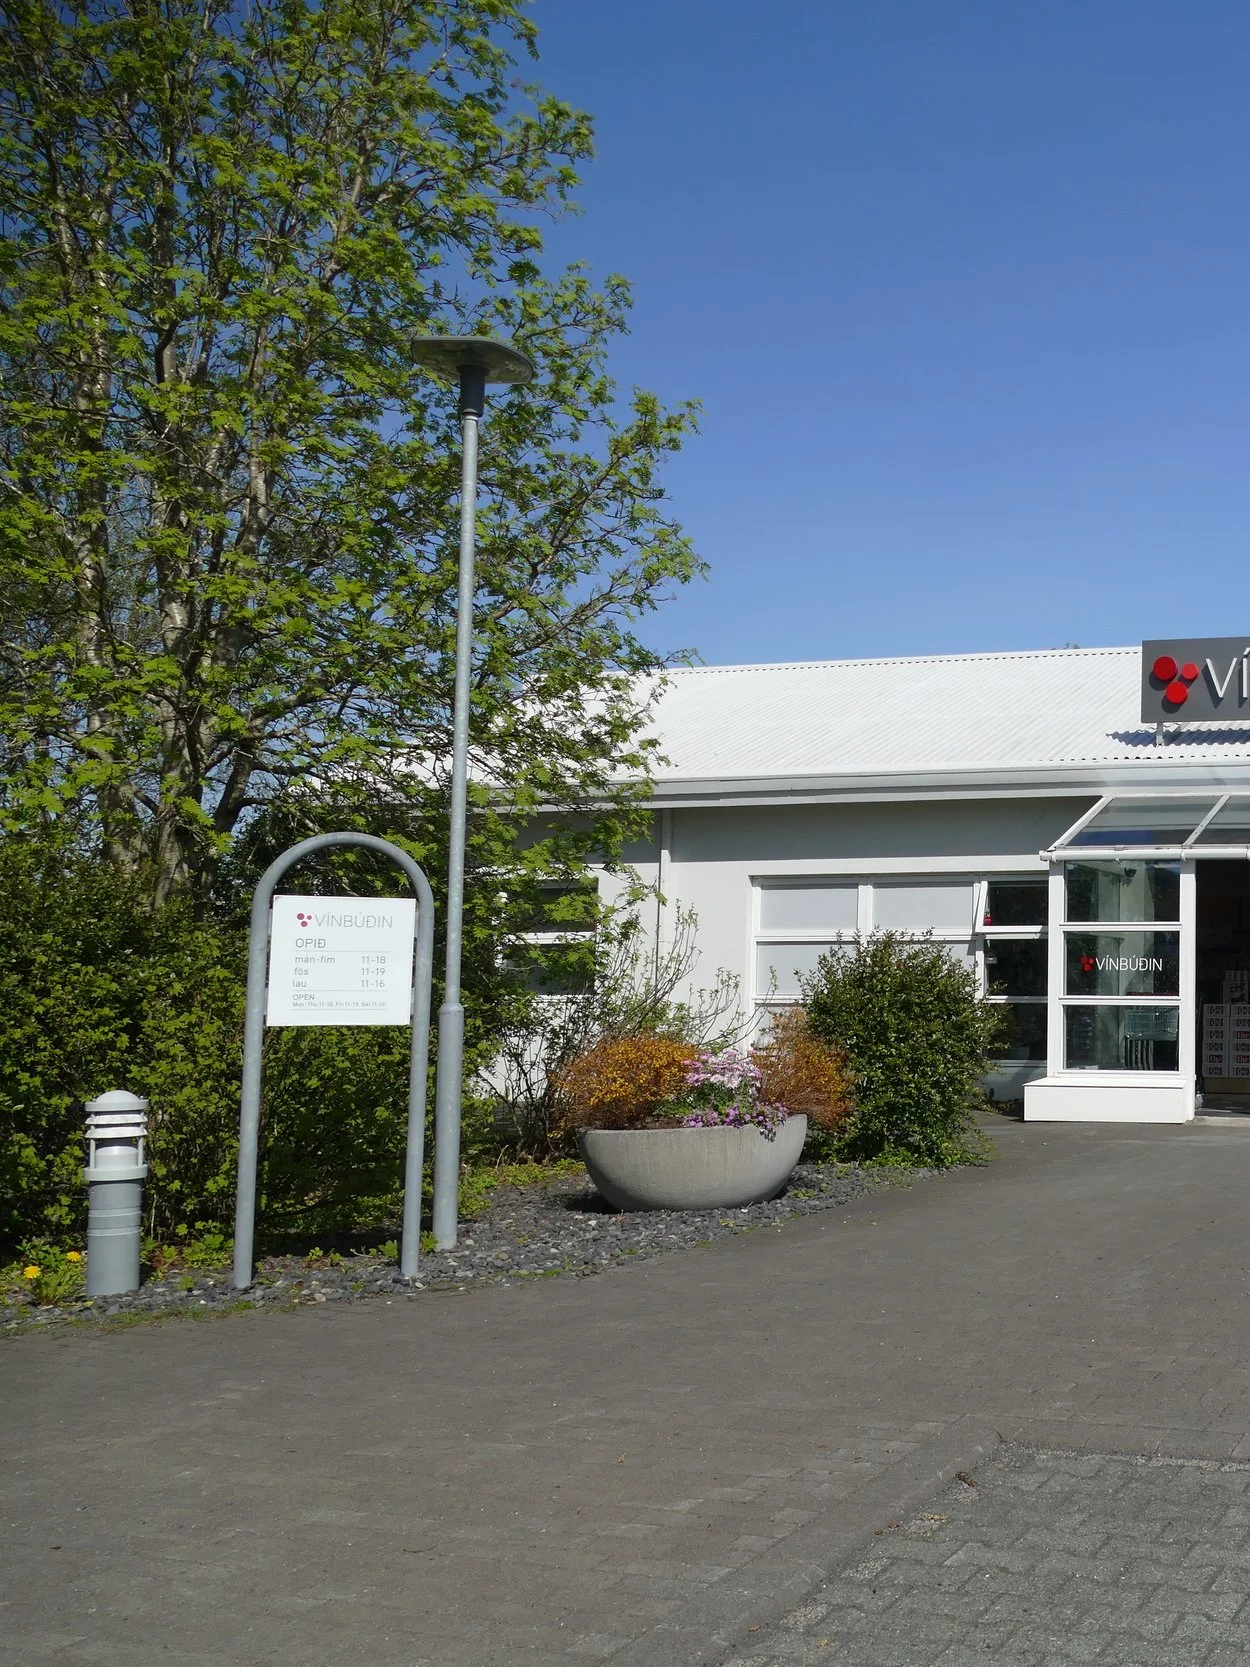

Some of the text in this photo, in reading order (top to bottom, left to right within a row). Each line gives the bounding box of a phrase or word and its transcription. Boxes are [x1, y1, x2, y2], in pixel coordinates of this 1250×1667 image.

[314, 912, 393, 929] VÍNBÚÐIN
[295, 938, 327, 949] OPIÐ
[361, 956, 386, 964] 11-18
[1095, 954, 1163, 971] VÍNBÚÐIN
[361, 967, 386, 976] 11-19
[292, 979, 385, 988] lau 11-16
[292, 993, 315, 1001] OPEN
